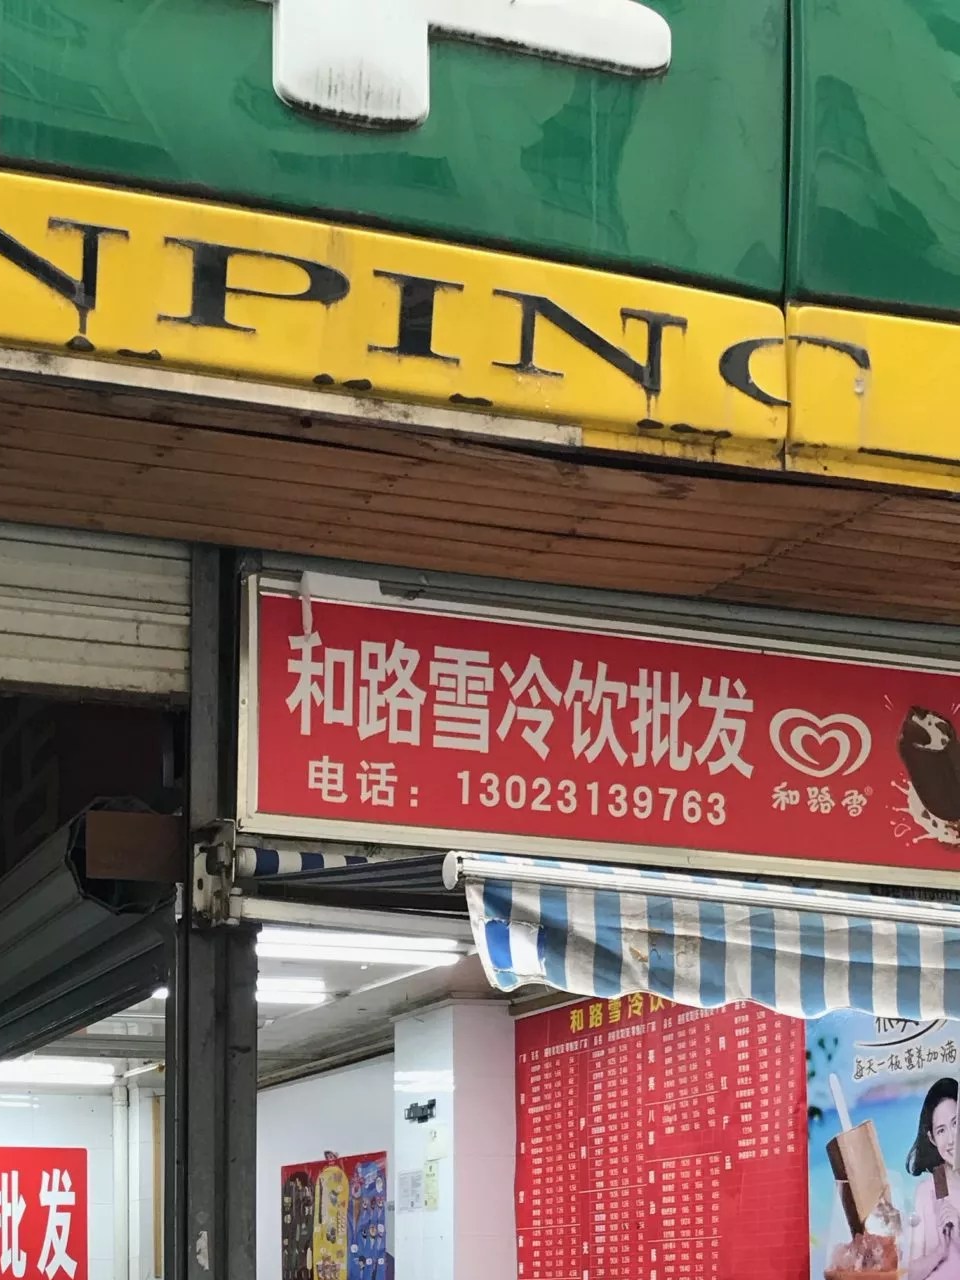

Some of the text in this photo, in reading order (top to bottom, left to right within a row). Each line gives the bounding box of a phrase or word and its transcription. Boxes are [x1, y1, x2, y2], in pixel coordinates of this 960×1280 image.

[286, 632, 754, 777] 和路雪冷饮批发
[457, 770, 727, 825] 13023139763
